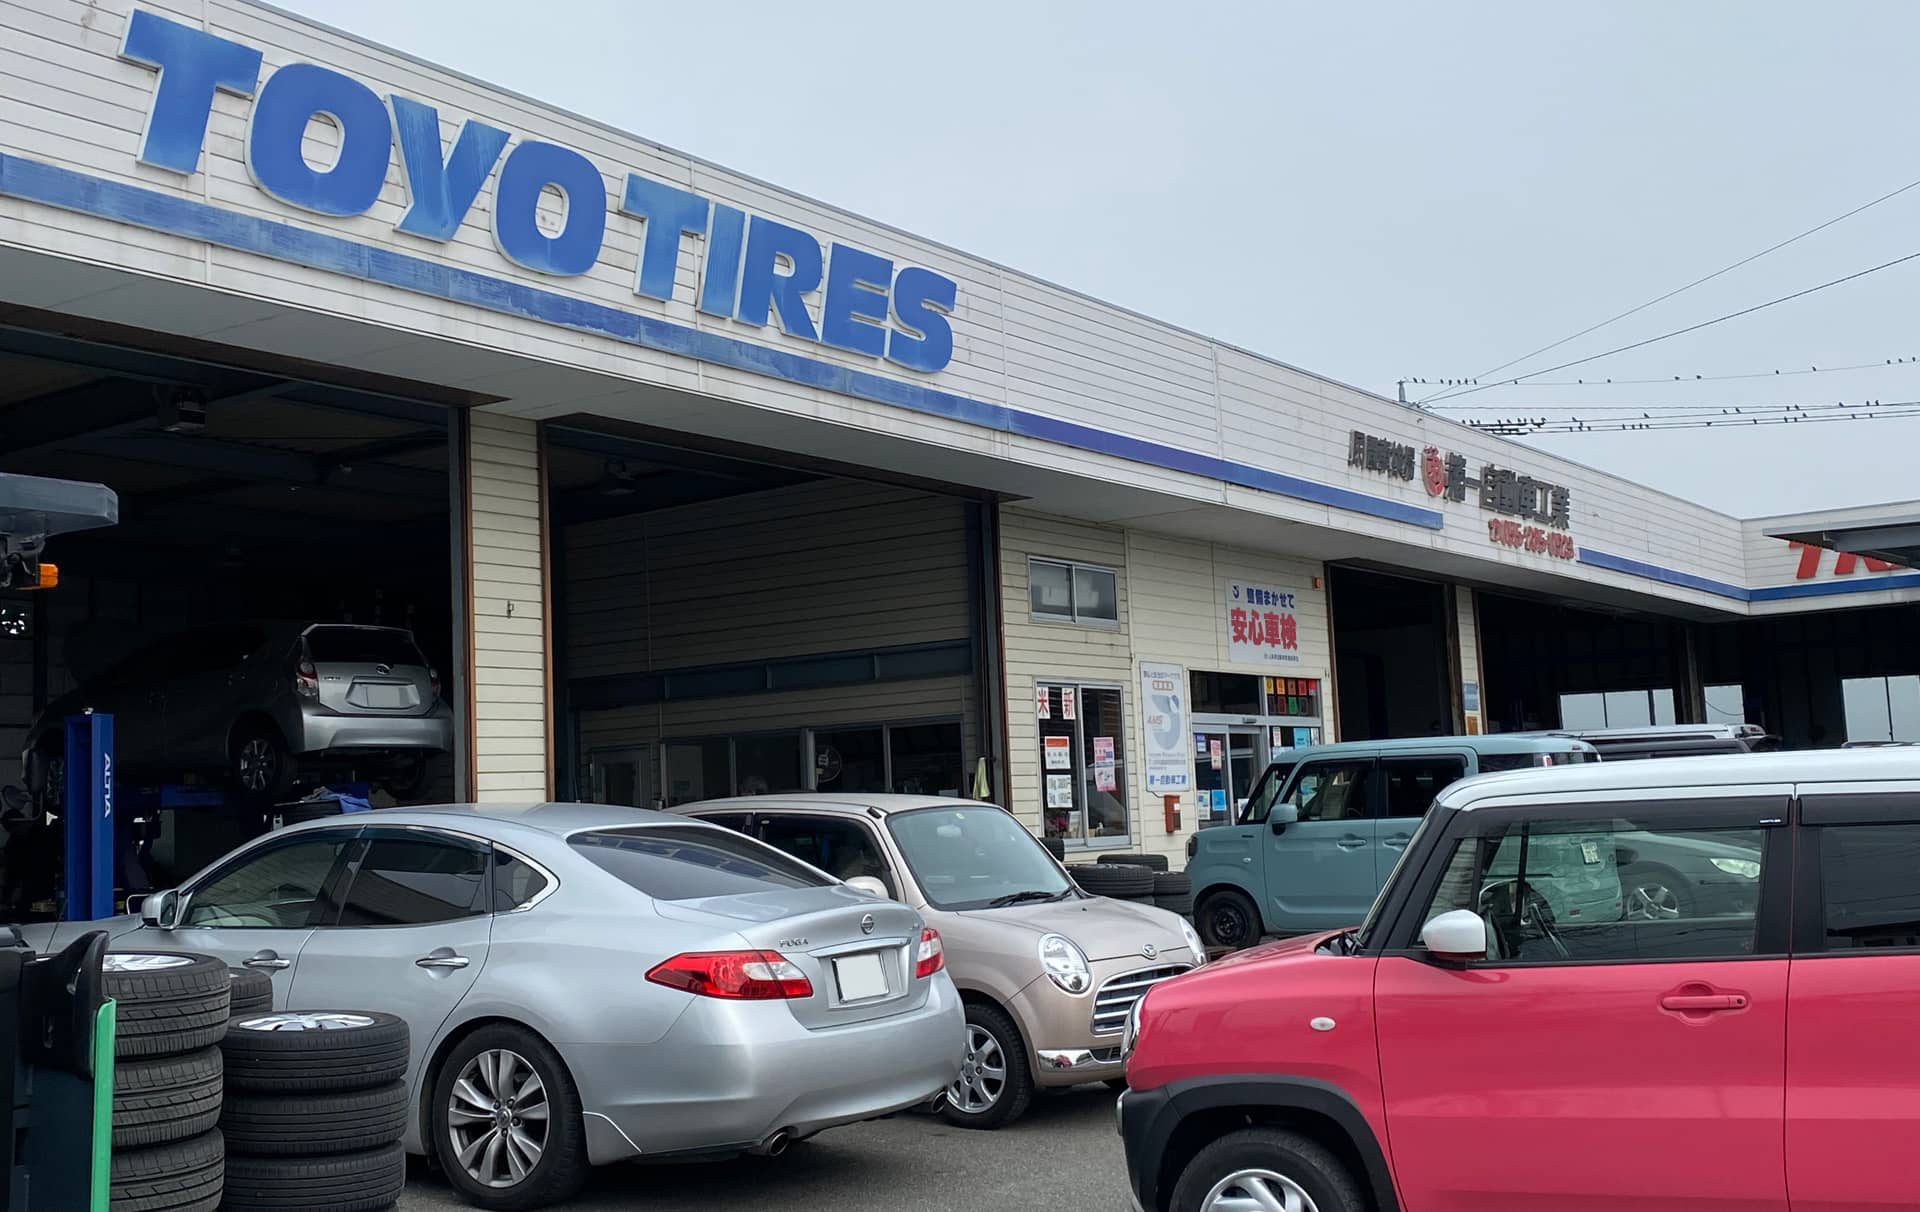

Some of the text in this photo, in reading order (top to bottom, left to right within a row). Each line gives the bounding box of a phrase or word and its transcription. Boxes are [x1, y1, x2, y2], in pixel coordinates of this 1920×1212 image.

[118, 9, 958, 374] TOYO TIRES
[1230, 606, 1298, 652] 安心車検
